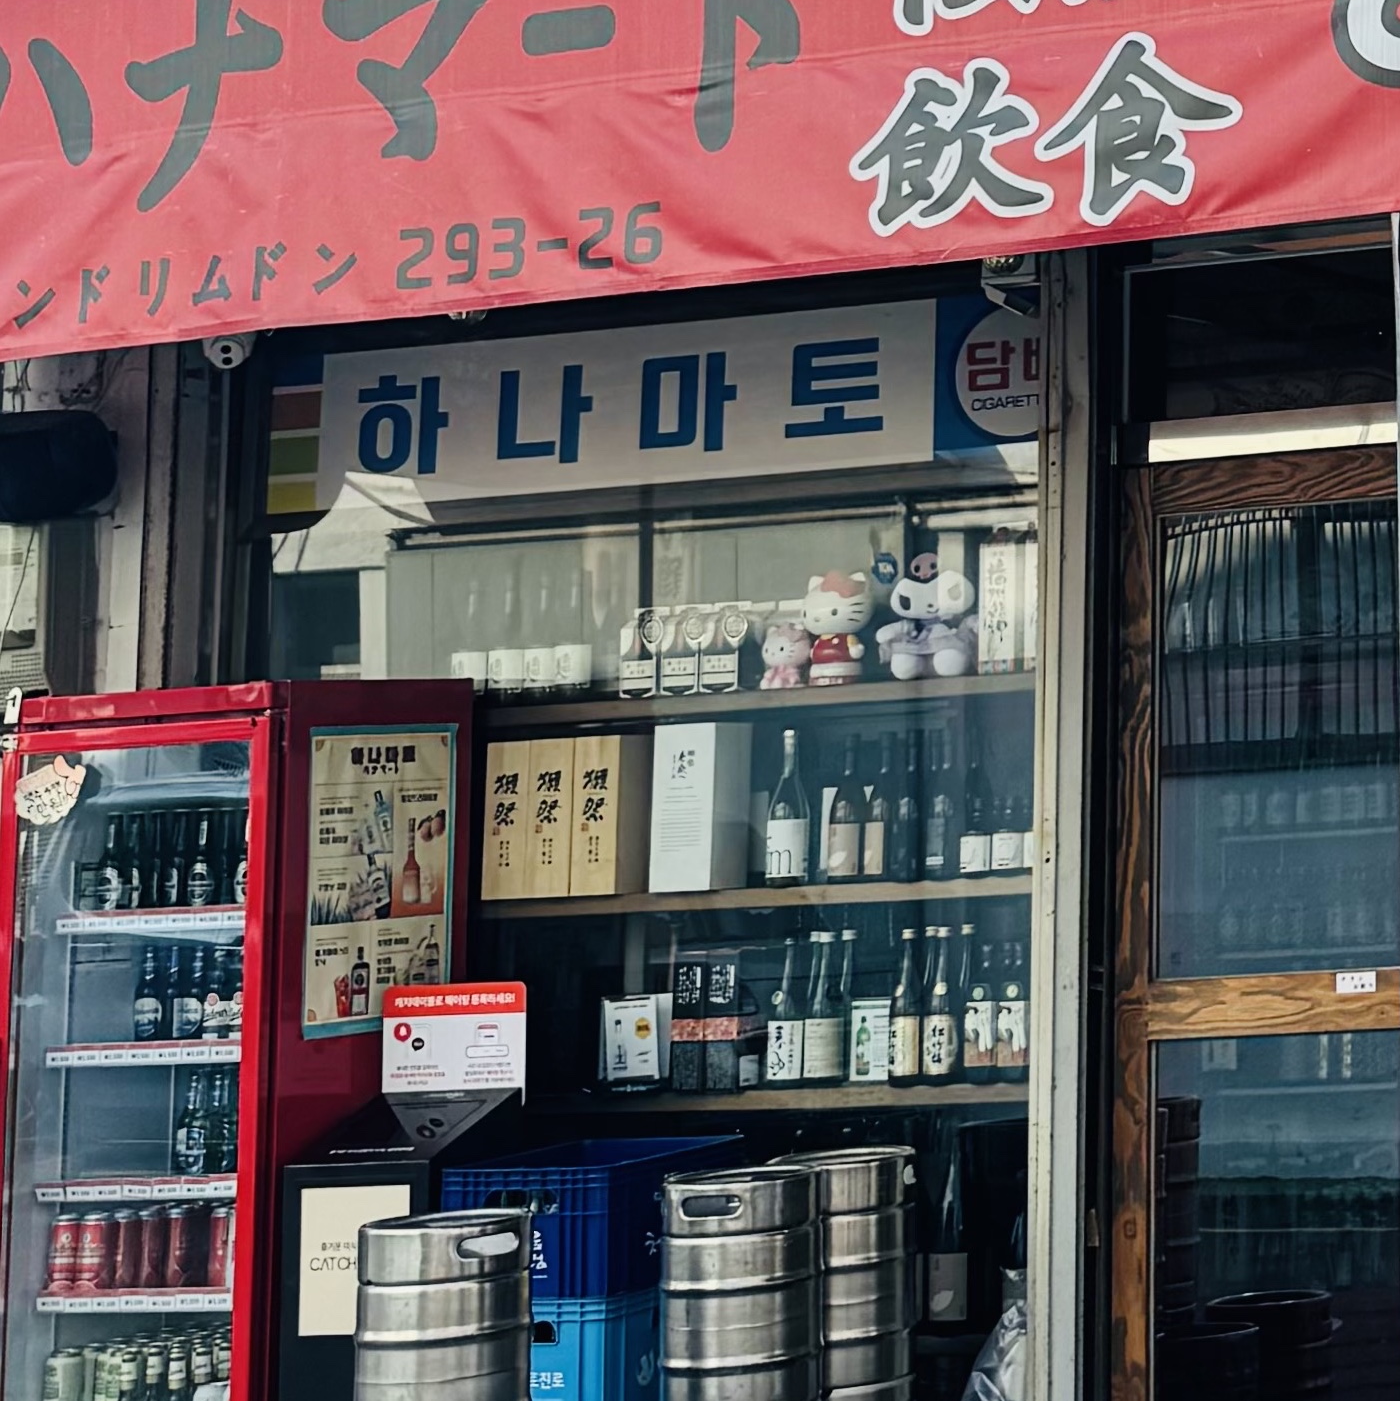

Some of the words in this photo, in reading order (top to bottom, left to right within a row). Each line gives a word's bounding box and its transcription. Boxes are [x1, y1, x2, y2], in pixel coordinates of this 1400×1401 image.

[849, 32, 1241, 239] 飲食
[396, 201, 663, 290] 293-26
[356, 337, 884, 474] 하나마토
[971, 394, 1040, 411] CIGARETT
